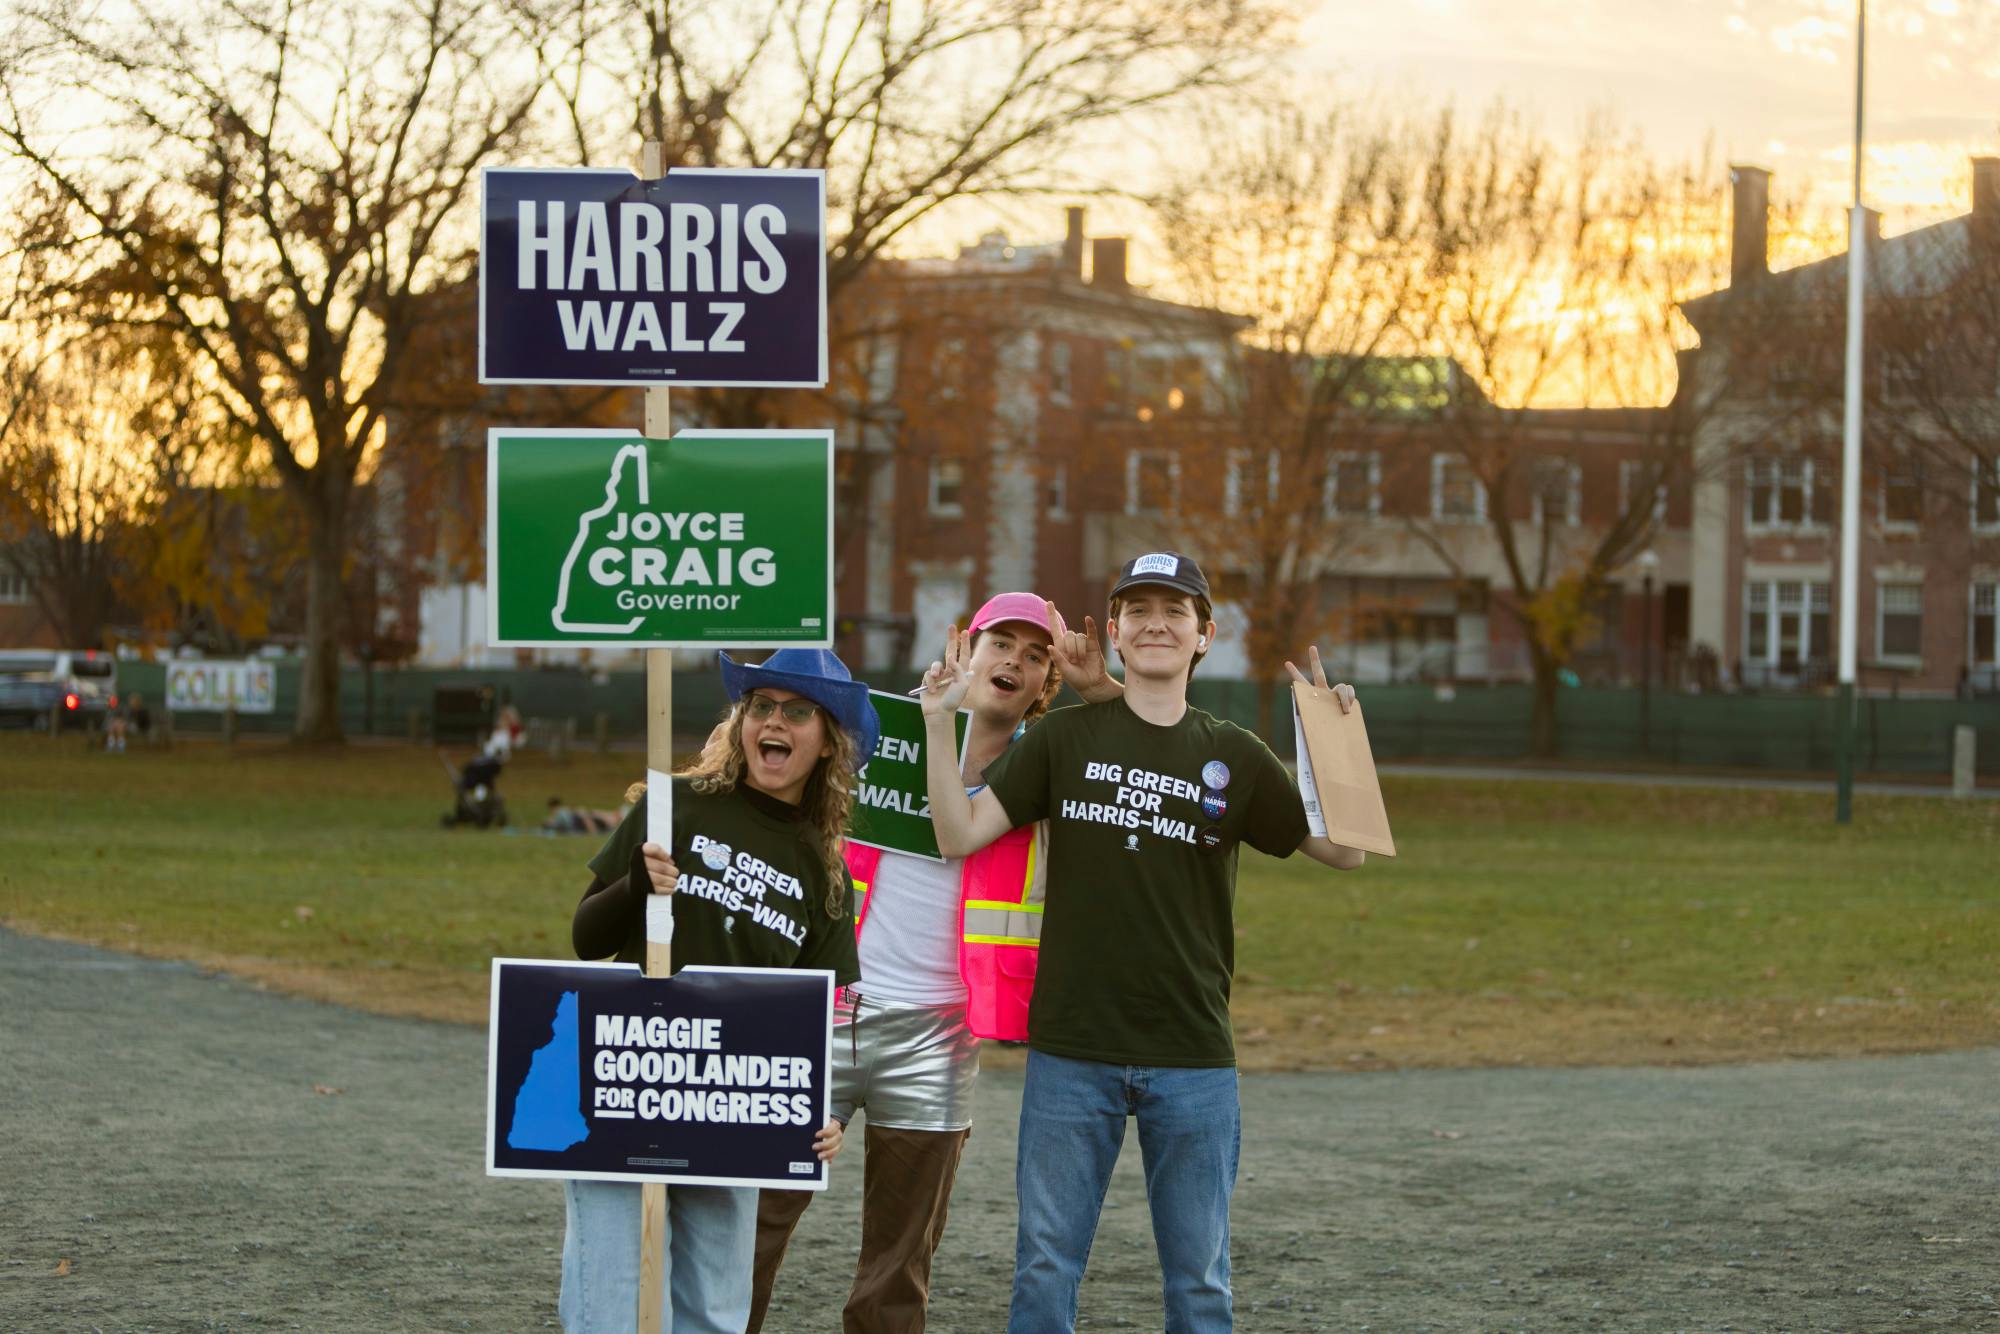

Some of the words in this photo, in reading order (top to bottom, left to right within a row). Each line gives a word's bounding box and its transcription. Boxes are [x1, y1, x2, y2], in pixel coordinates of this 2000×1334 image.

[518, 200, 787, 294] HARRIS
[557, 300, 745, 352] WALZ
[606, 512, 744, 541] JOYCE
[588, 547, 776, 586] CRAIG
[1137, 555, 1174, 568] HARRIS
[616, 589, 741, 610] Governor
[168, 669, 272, 705] COLLIS
[1085, 761, 1123, 783] BIG
[1127, 768, 1200, 803] GREEN
[1115, 786, 1163, 813] FOR
[722, 866, 767, 902] FOR
[735, 852, 804, 900] GREEN
[595, 1014, 722, 1050] MAGGIE
[594, 1050, 812, 1088] GOODLANDER
[594, 1087, 635, 1109] FOR
[638, 1088, 812, 1126] CONGRESS
